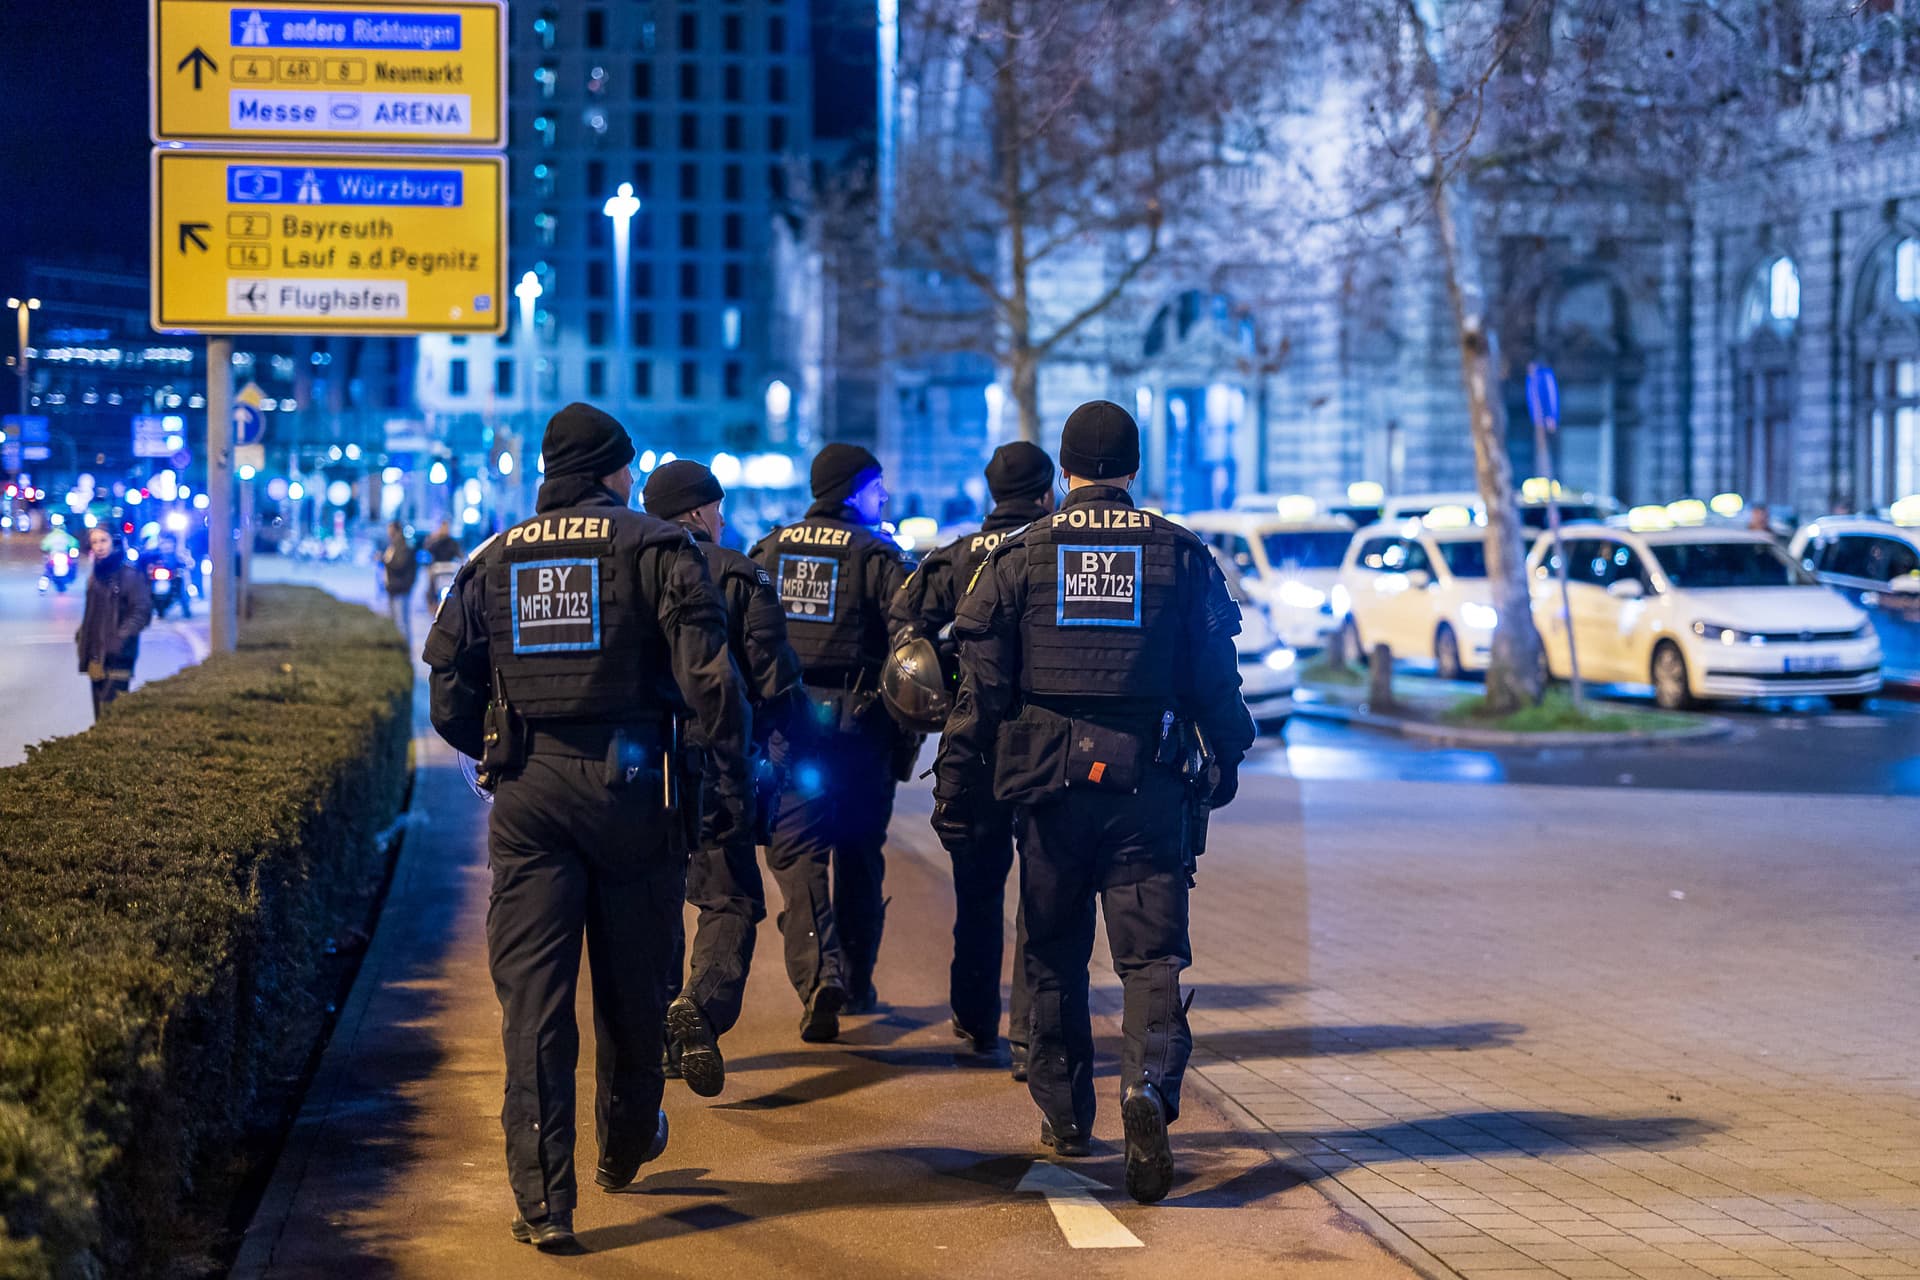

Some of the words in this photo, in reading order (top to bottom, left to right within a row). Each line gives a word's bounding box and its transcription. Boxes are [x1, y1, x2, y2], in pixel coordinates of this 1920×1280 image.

[282, 18, 346, 42] andere
[353, 18, 455, 49] Richtungen
[247, 62, 258, 77] 4
[375, 62, 463, 84] Neumarkt
[239, 101, 317, 122] Messe
[374, 103, 462, 124] ARENA
[253, 175, 264, 194] 3
[337, 174, 456, 205] Würzburg
[243, 216, 255, 233] 2
[282, 216, 393, 242] Bayreuth
[239, 246, 259, 265] 14
[282, 247, 336, 269] Lauf
[279, 288, 400, 315] Flughafen
[1052, 509, 1150, 529] POLIZEI
[506, 517, 610, 546] POLIZEI
[778, 526, 852, 545] POLIZEI
[796, 562, 820, 580] BY
[1081, 552, 1117, 573] BY
[538, 567, 572, 593] BY
[783, 578, 804, 597] MFR
[806, 580, 829, 599] 7123
[1065, 573, 1097, 596] MFR
[1101, 573, 1134, 597] 7123
[520, 593, 552, 620] MFR
[555, 592, 589, 617] 7123
